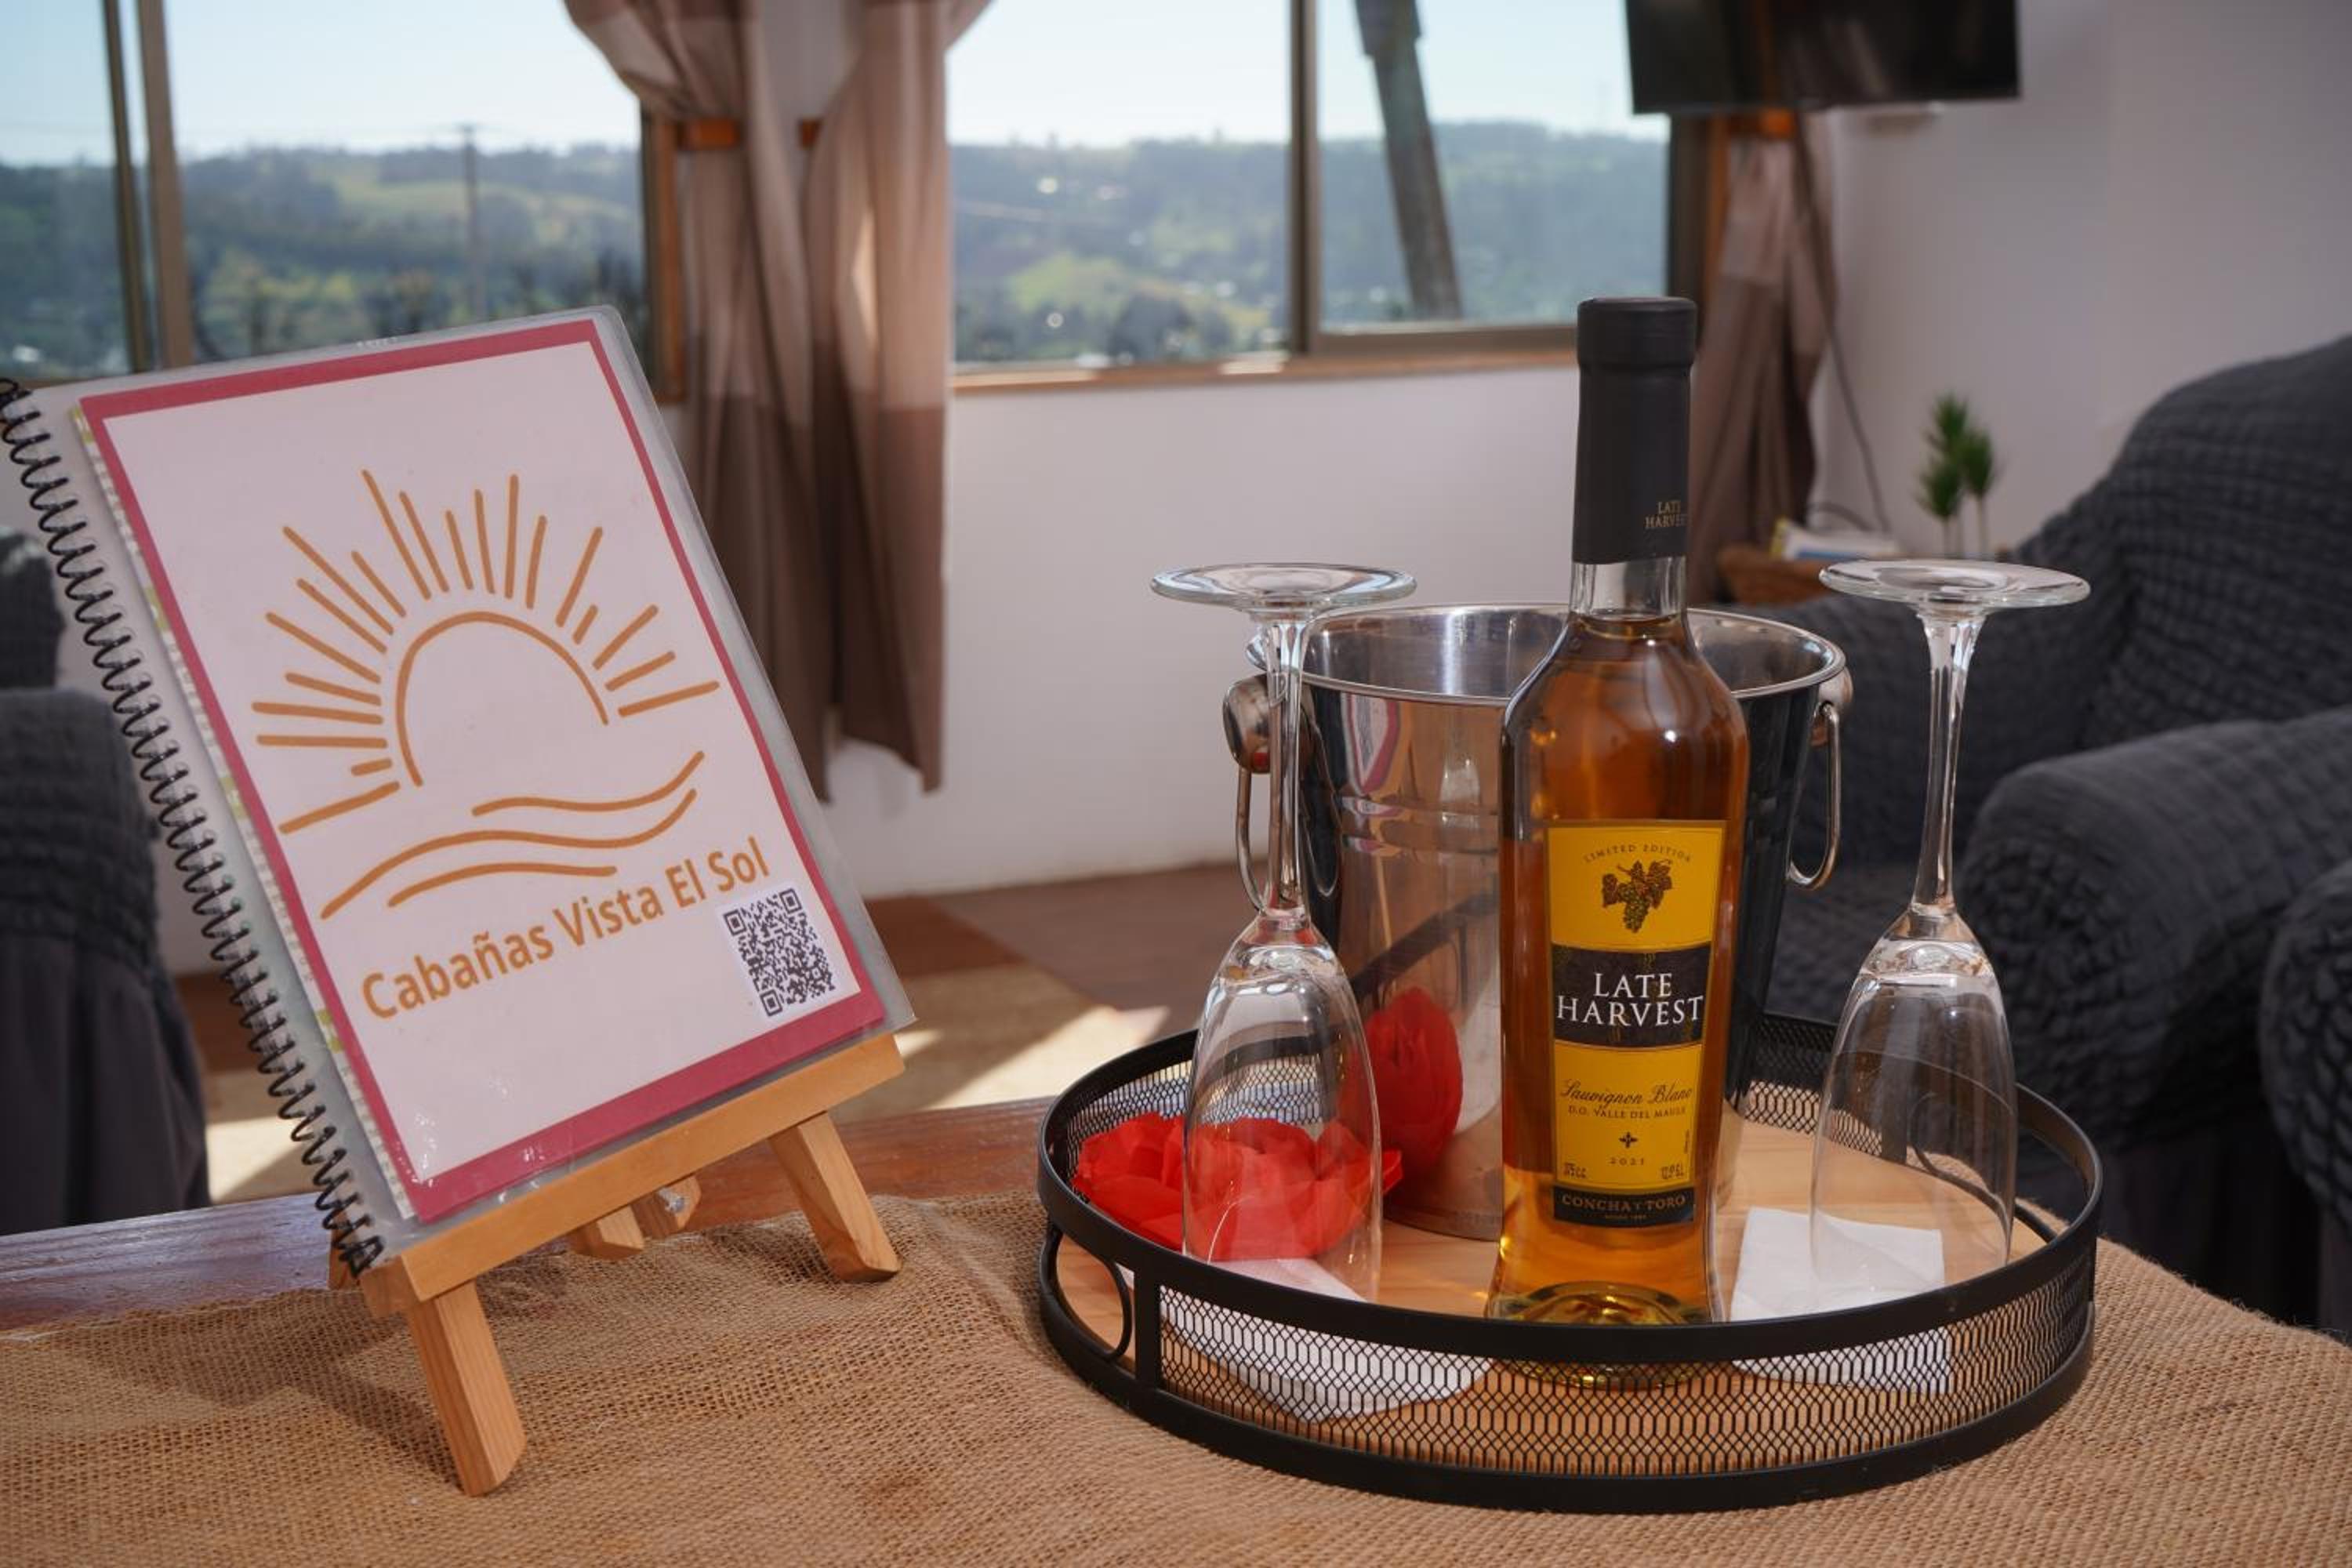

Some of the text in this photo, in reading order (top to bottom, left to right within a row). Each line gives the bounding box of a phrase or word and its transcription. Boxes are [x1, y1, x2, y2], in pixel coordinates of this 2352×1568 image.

[1584, 844, 1691, 863] LIMITED EDITION
[361, 833, 771, 1019] Cabañas Vista El Sol
[1593, 972, 1673, 1000] LATE
[1556, 995, 1704, 1028] HARVEST
[1559, 1078, 1693, 1109] Sauvignon Blanc
[1594, 1107, 1627, 1119] VALLE
[1630, 1109, 1650, 1120] DEL
[1609, 1157, 1645, 1167] 2021
[1561, 1193, 1632, 1212] CONCHA
[1644, 1194, 1686, 1211] TORO
